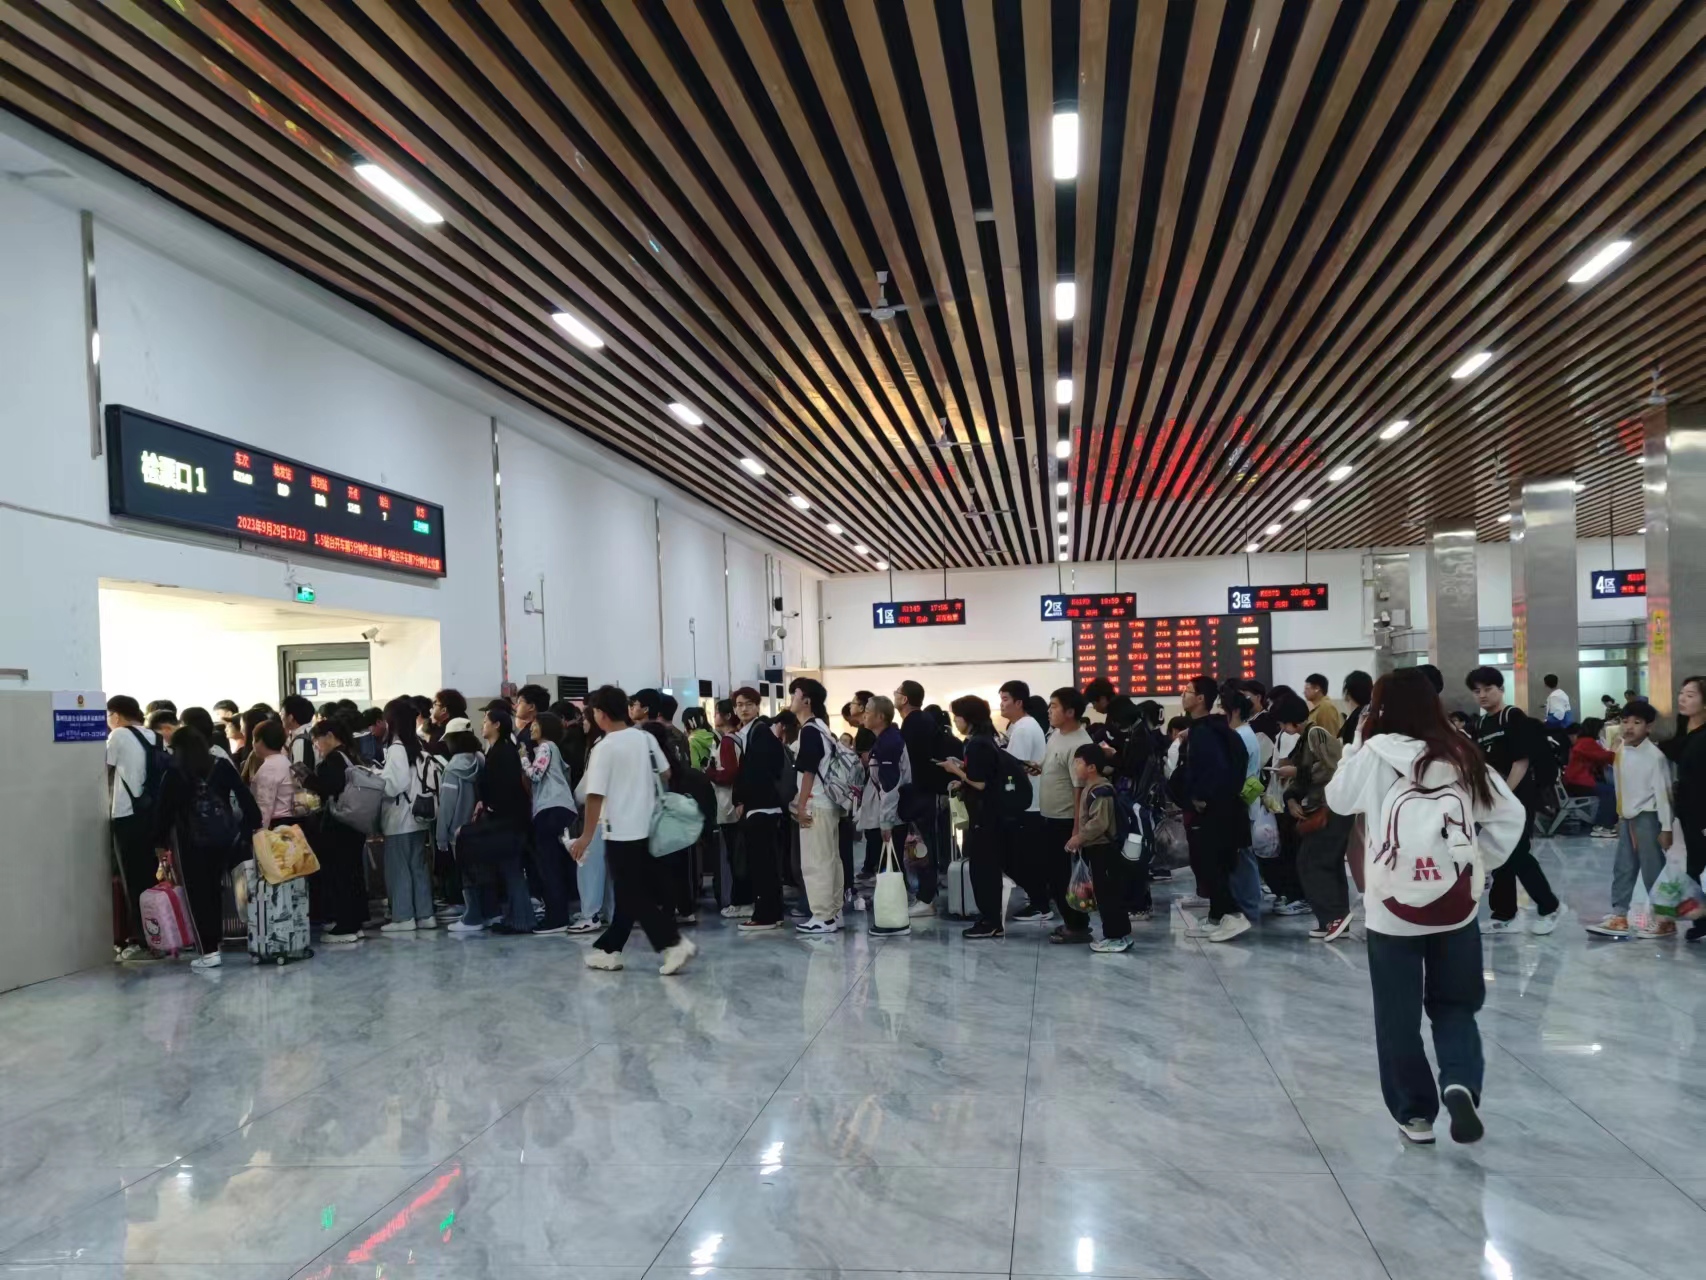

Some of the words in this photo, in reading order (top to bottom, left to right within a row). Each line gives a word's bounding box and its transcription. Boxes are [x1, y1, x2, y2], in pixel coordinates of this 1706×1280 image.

[235, 451, 251, 469] 车次
[237, 515, 288, 539] 2023年9月29日
[288, 527, 306, 542] 17:23
[319, 677, 361, 689] 客运值班室
[1413, 855, 1443, 881] M
